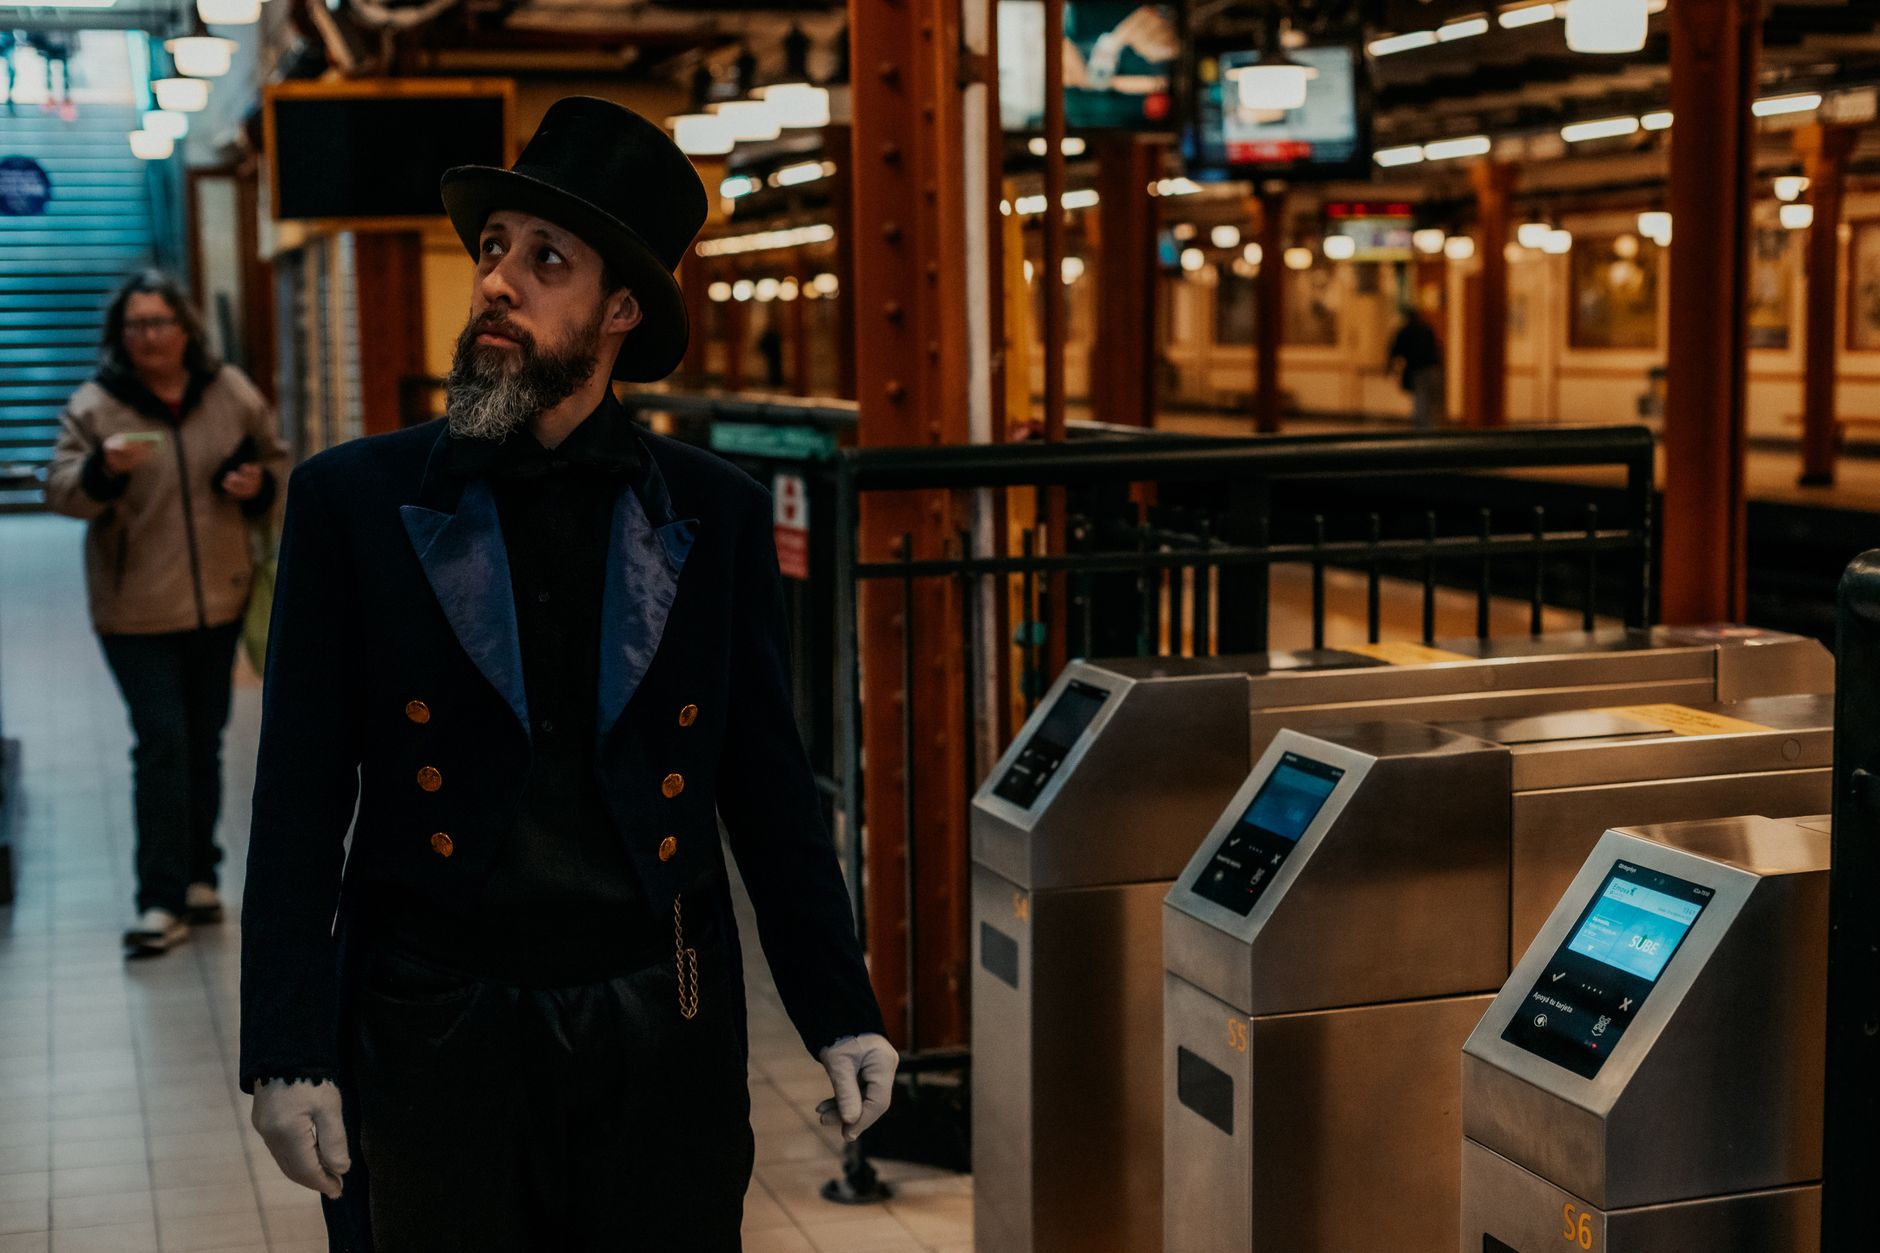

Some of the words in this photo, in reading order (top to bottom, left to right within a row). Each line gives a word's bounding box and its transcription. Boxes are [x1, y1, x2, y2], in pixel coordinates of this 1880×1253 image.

[1628, 935, 1659, 955] SUBE
[1227, 1019, 1247, 1051] S5
[1562, 1202, 1592, 1249] S6
